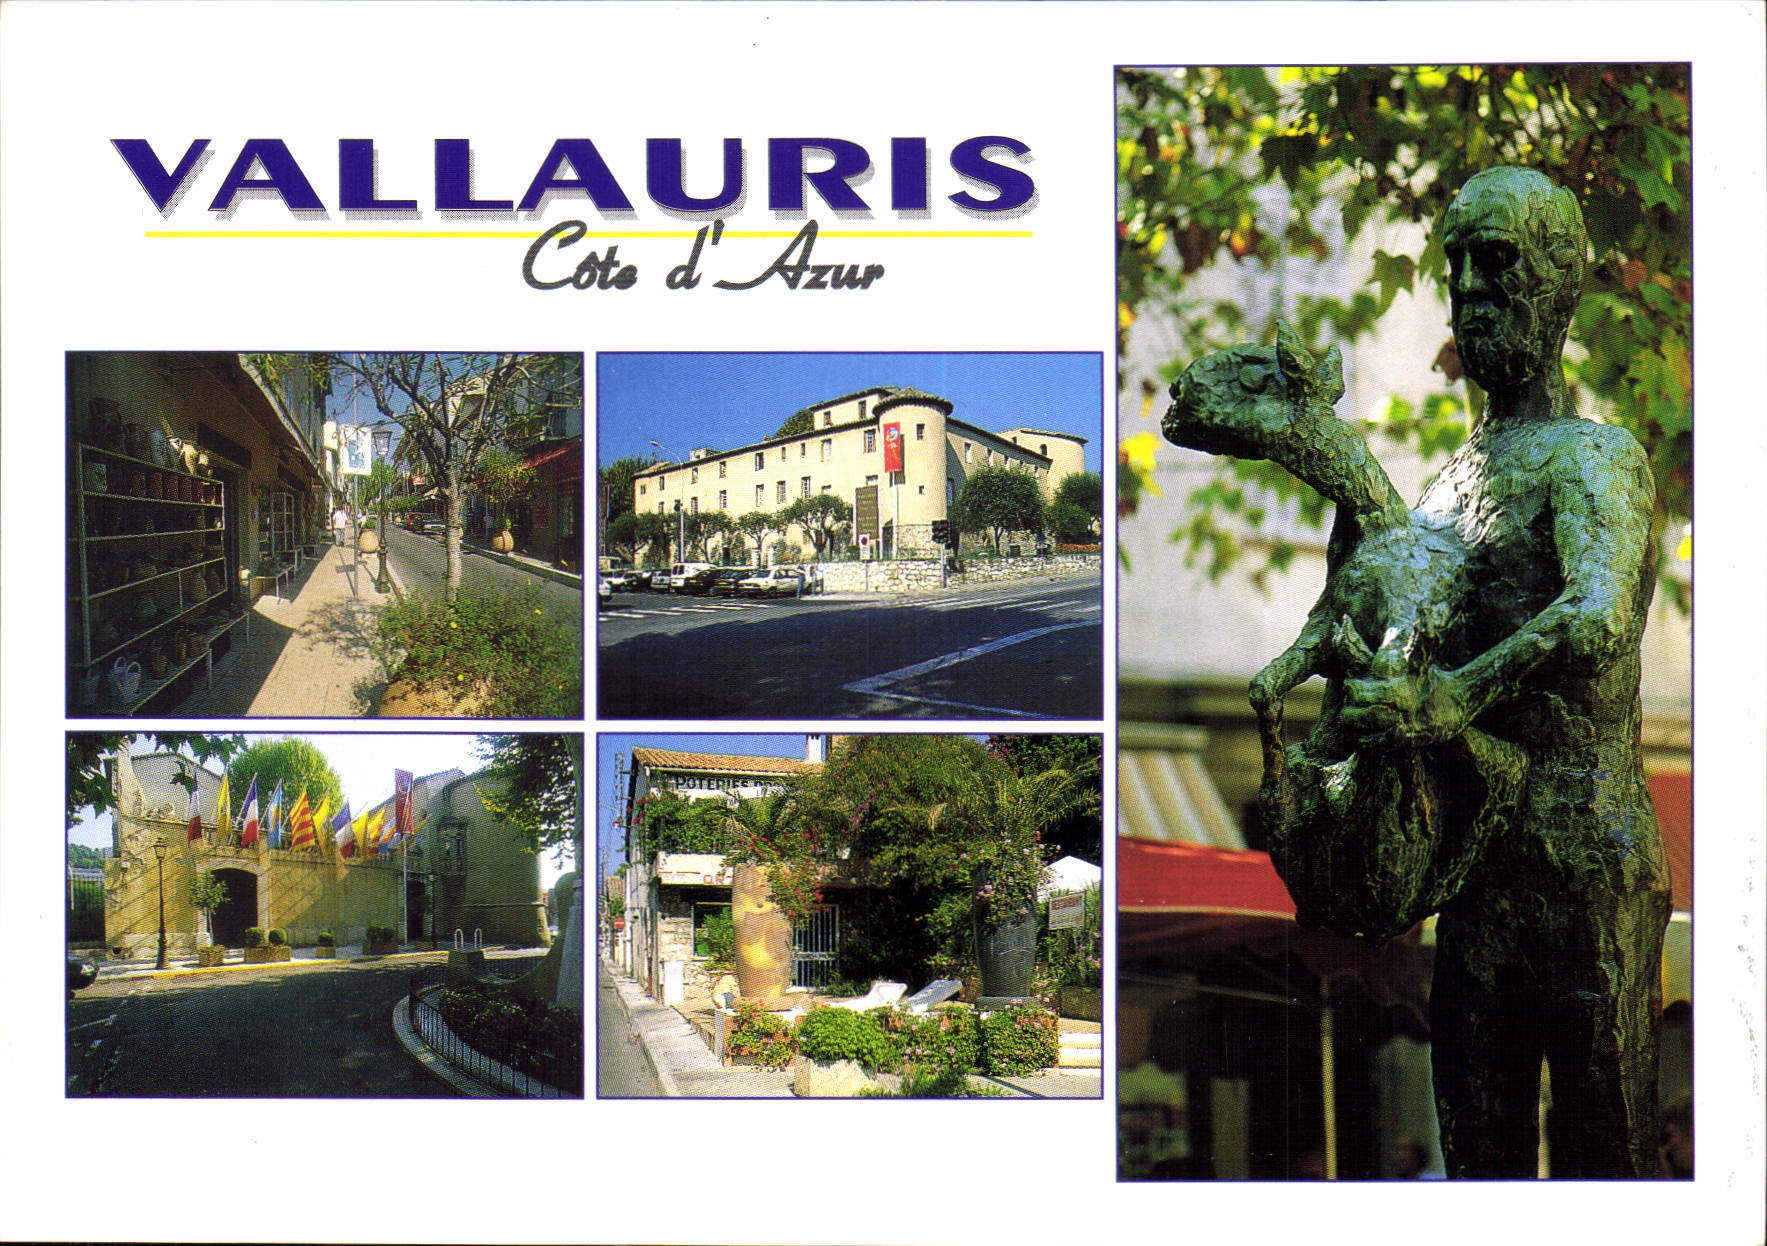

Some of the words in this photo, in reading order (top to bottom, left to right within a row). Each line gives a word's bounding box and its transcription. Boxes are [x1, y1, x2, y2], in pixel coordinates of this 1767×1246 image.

[110, 136, 1038, 218] VALLAURIS
[522, 219, 638, 291] Côte
[675, 775, 747, 790] POTERIES
